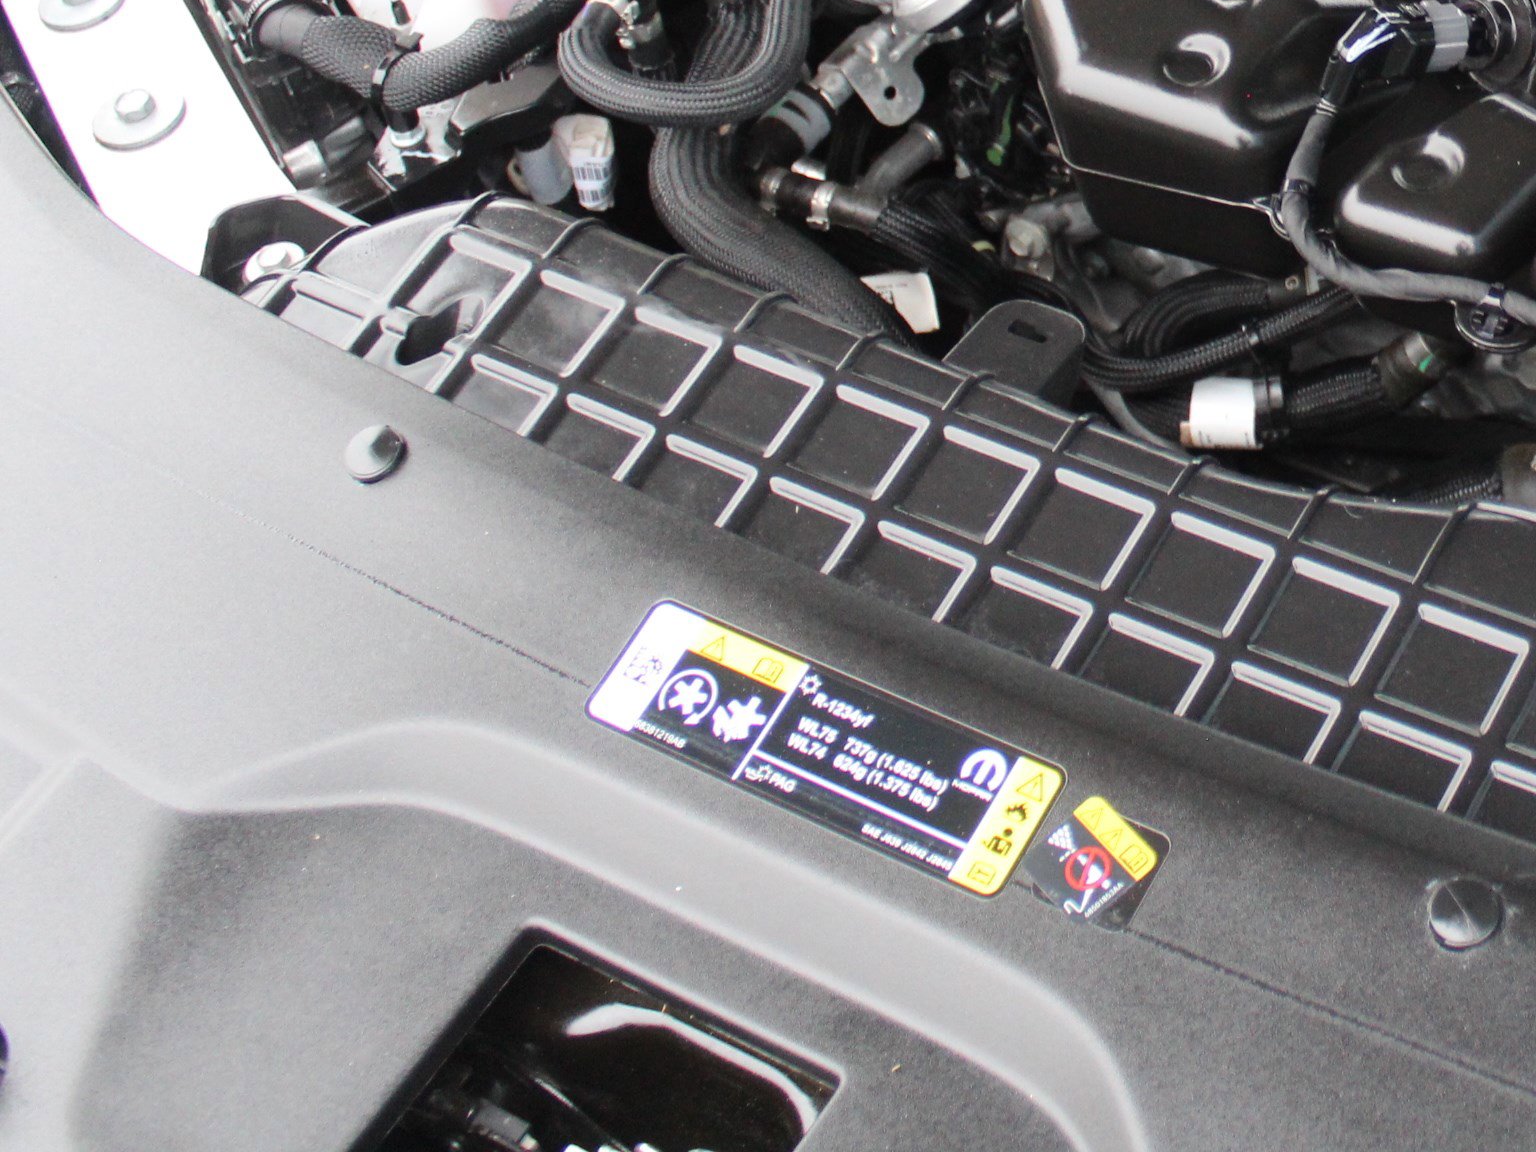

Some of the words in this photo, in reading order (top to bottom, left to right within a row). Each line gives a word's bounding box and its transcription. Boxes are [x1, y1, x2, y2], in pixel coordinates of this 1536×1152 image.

[811, 692, 876, 728] R-1234yf
[798, 716, 840, 744] WL75
[843, 736, 878, 765] 737g
[768, 771, 797, 793] PAG
[787, 732, 829, 760] WL74
[866, 769, 912, 797] (1.375
[909, 786, 940, 812] lbs)
